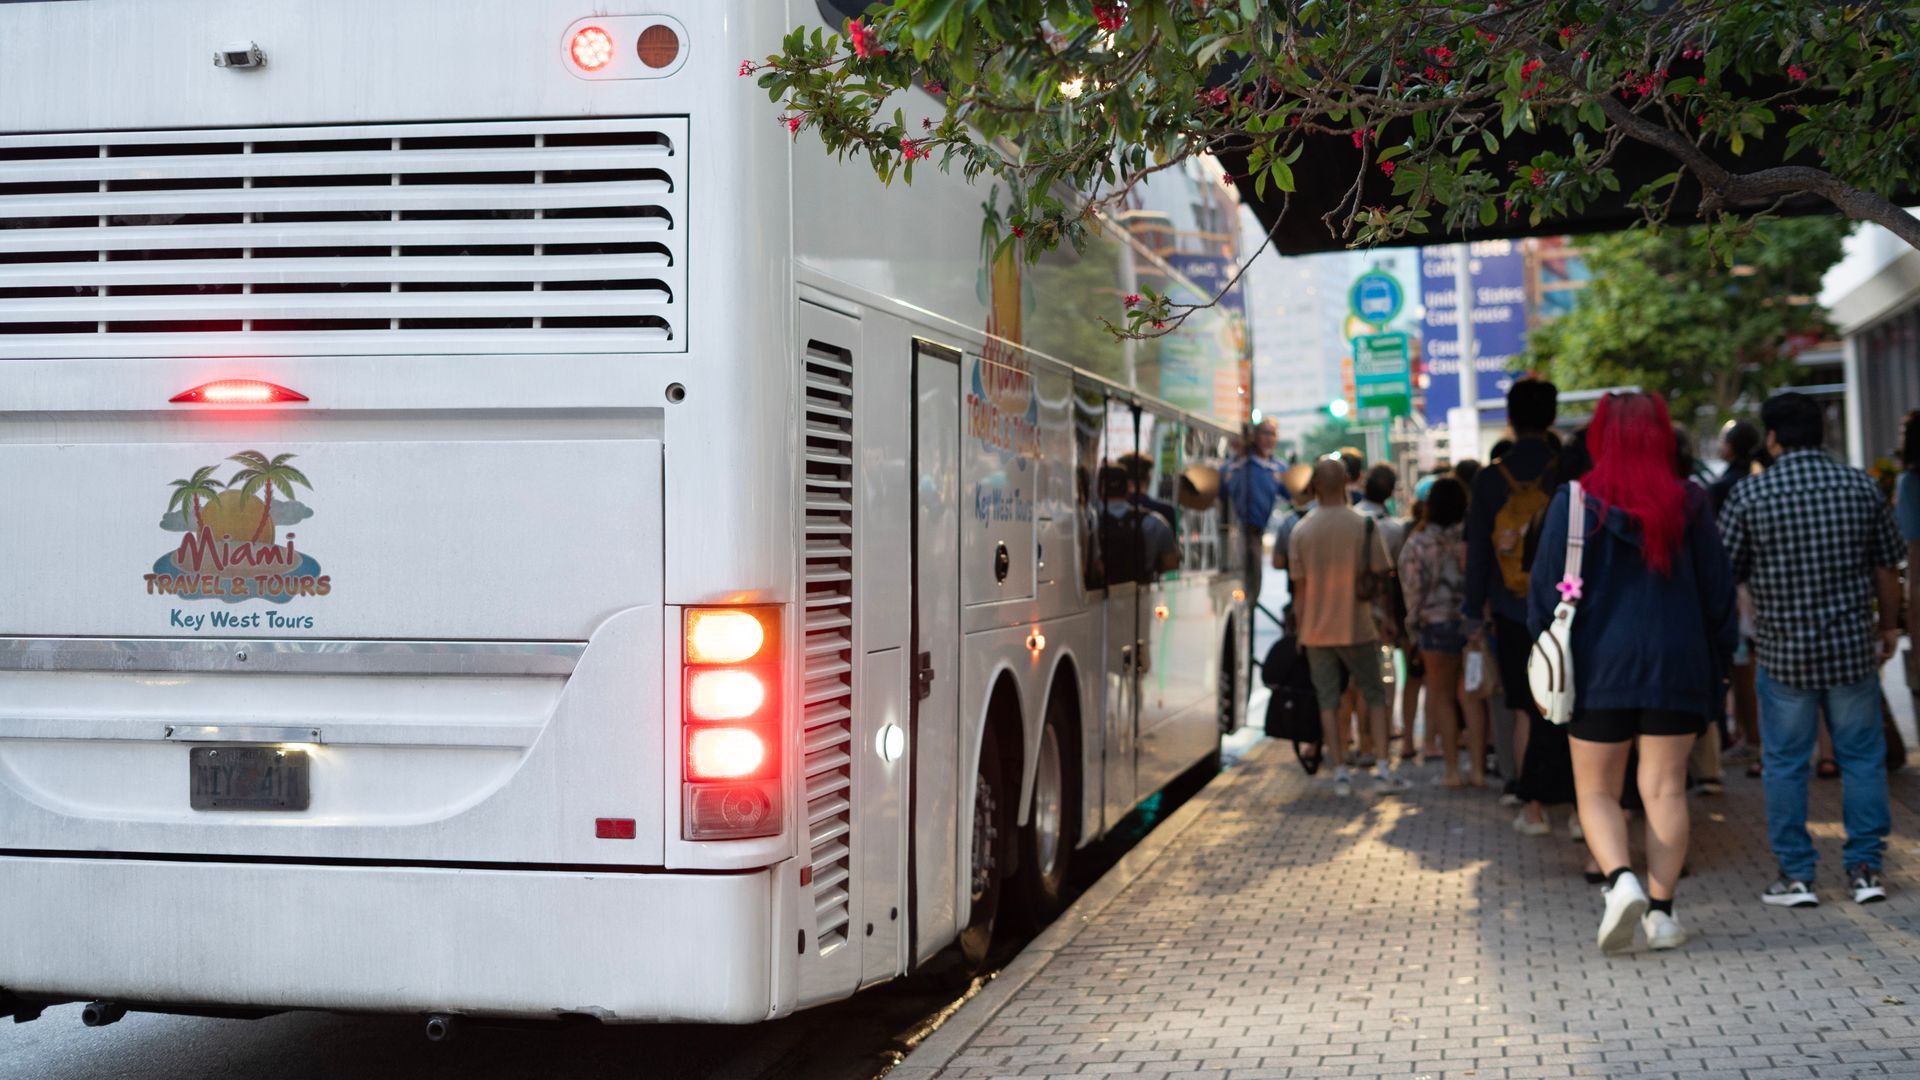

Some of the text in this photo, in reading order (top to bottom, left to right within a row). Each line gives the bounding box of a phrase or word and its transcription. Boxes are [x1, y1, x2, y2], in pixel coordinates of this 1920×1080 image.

[1423, 260, 1482, 277] Collee
[1477, 286, 1527, 304] States
[1426, 305, 1512, 327] Cououse
[1427, 339, 1482, 358] Couy
[1428, 354, 1507, 375] Couous
[967, 393, 1001, 447] TRAVEL
[1013, 416, 1041, 460] TOURS
[975, 480, 1034, 528] Key West Tours
[178, 526, 296, 572] Miami
[143, 573, 332, 598] TRAVEL & TOURS
[170, 608, 314, 631] Key West Tours
